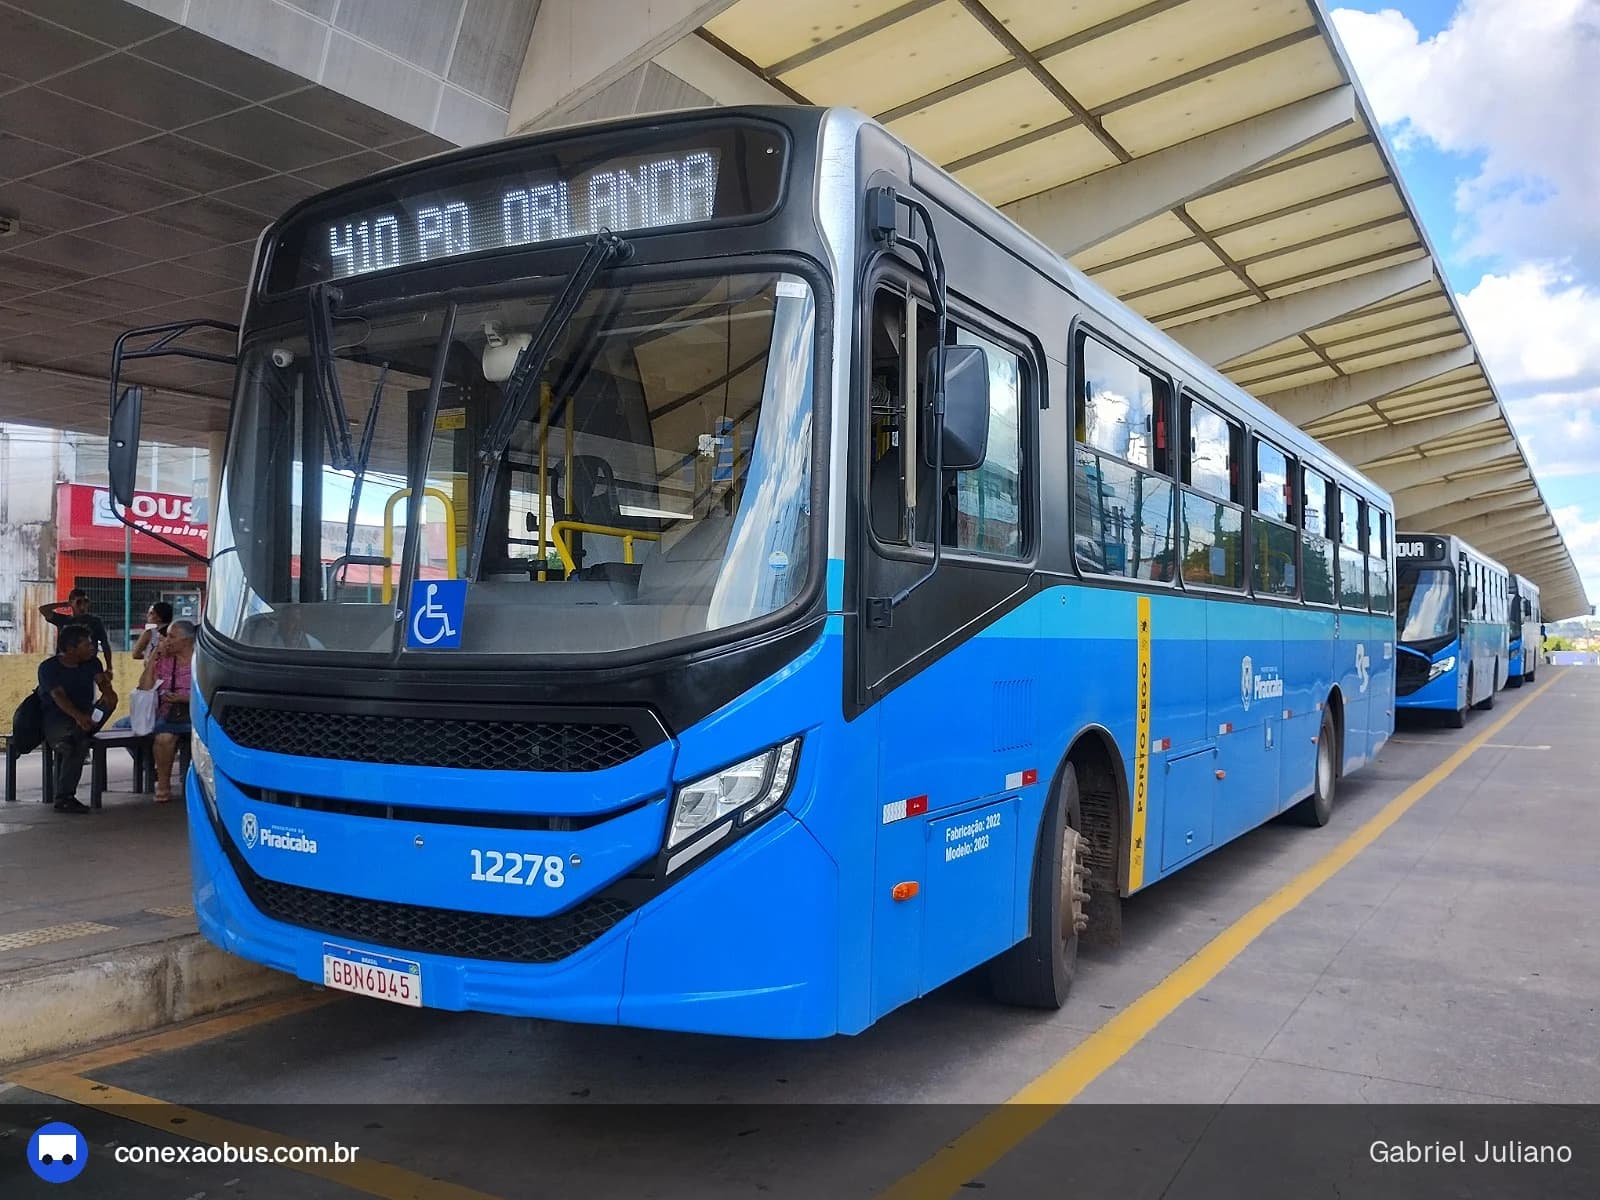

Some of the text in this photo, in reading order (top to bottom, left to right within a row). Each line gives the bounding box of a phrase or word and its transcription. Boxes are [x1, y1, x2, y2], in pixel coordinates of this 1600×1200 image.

[329, 215, 400, 275] 410
[503, 152, 715, 247] ORLANDA
[1137, 662, 1147, 812] PONTO CEGO
[260, 828, 317, 854] Piracicaba
[945, 812, 1001, 842] Fabricação: 2022
[945, 834, 989, 862] Modelo: 2023
[470, 849, 565, 888] 12278
[333, 960, 410, 999] GBN6D45
